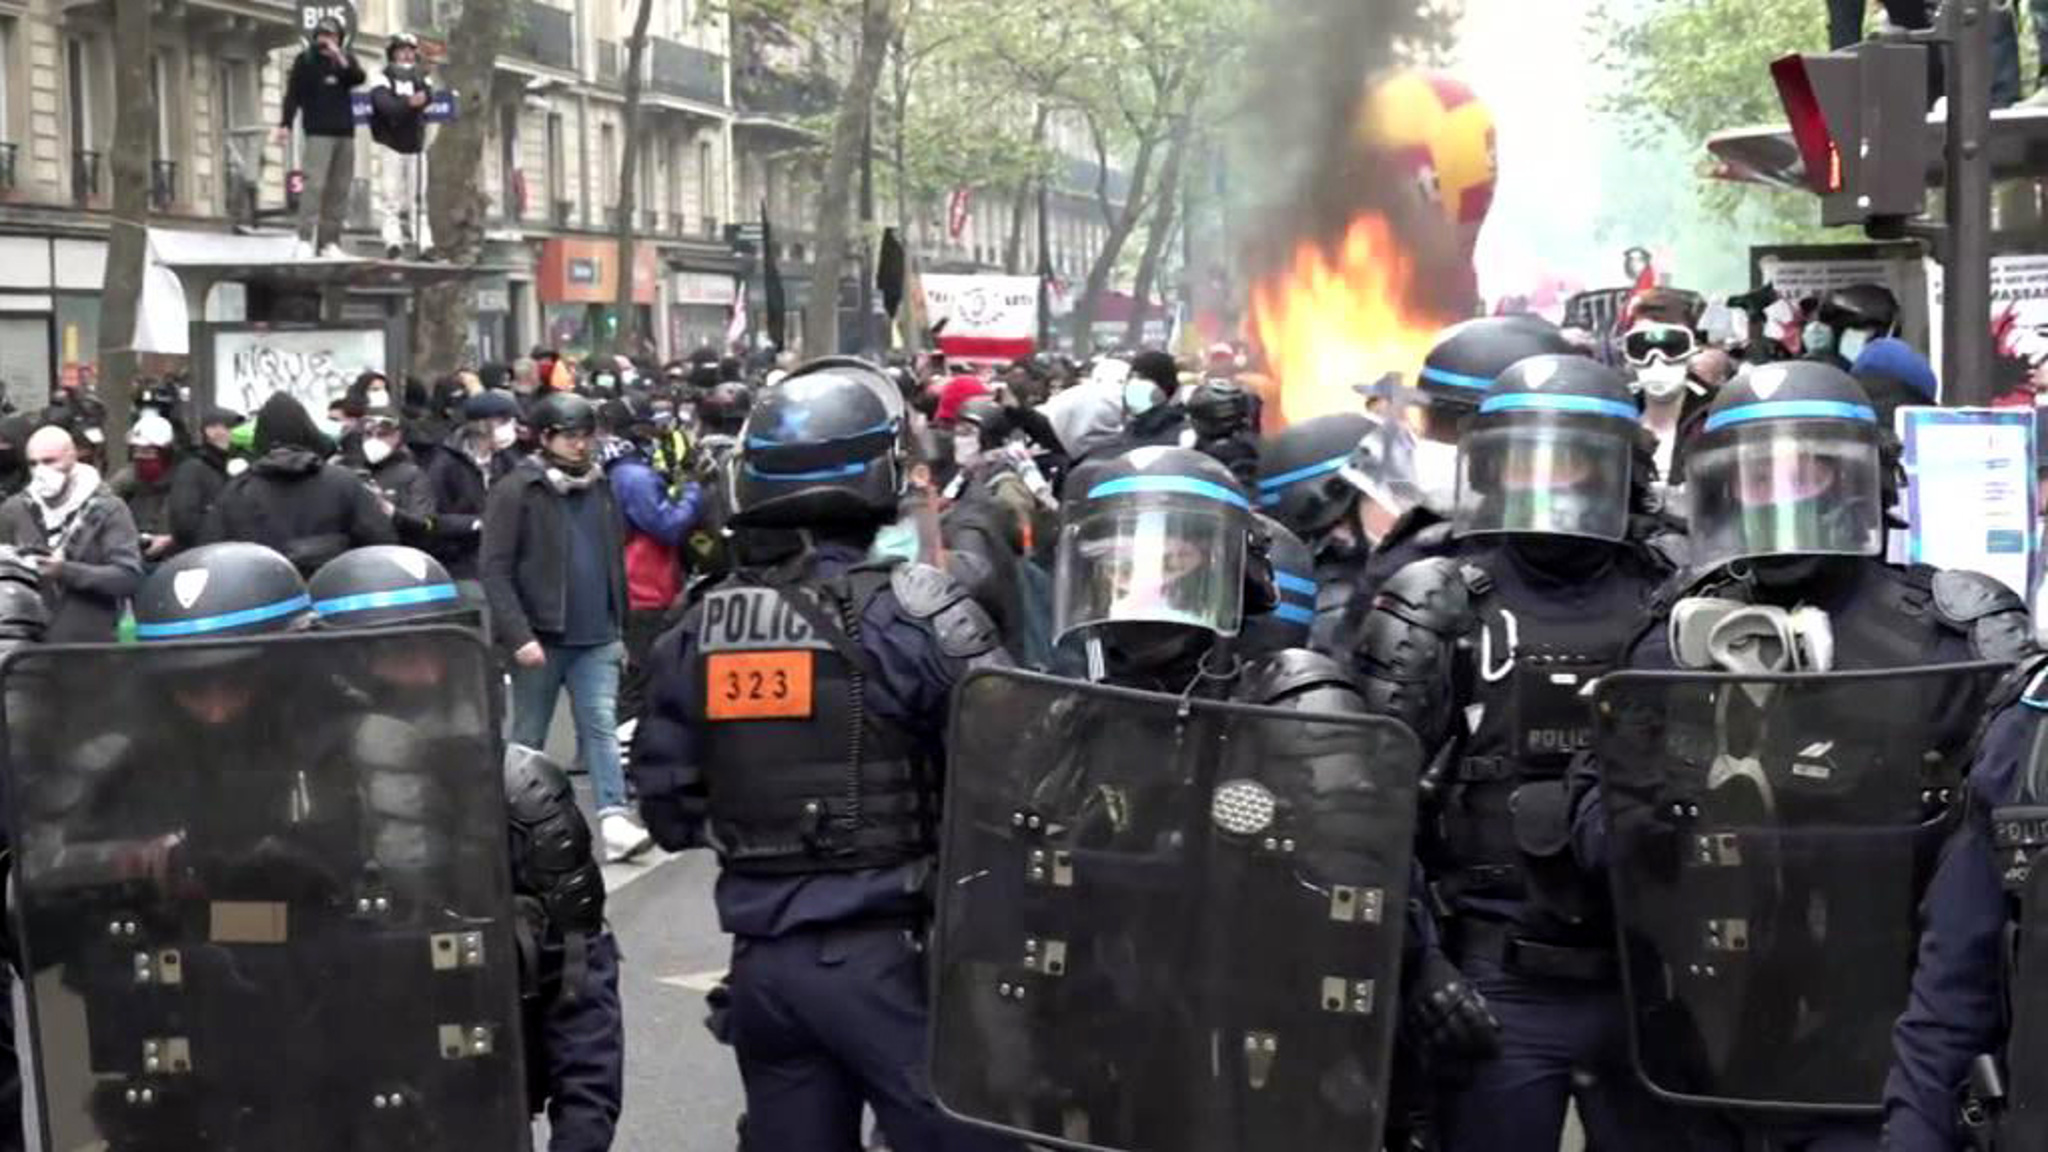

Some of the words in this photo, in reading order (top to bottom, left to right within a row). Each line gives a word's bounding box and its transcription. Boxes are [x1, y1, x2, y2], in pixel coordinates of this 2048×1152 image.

[704, 592, 808, 643] POLIC
[726, 669, 788, 700] 323
[1528, 728, 1592, 749] POLIC
[1996, 821, 2048, 840] POLIC
